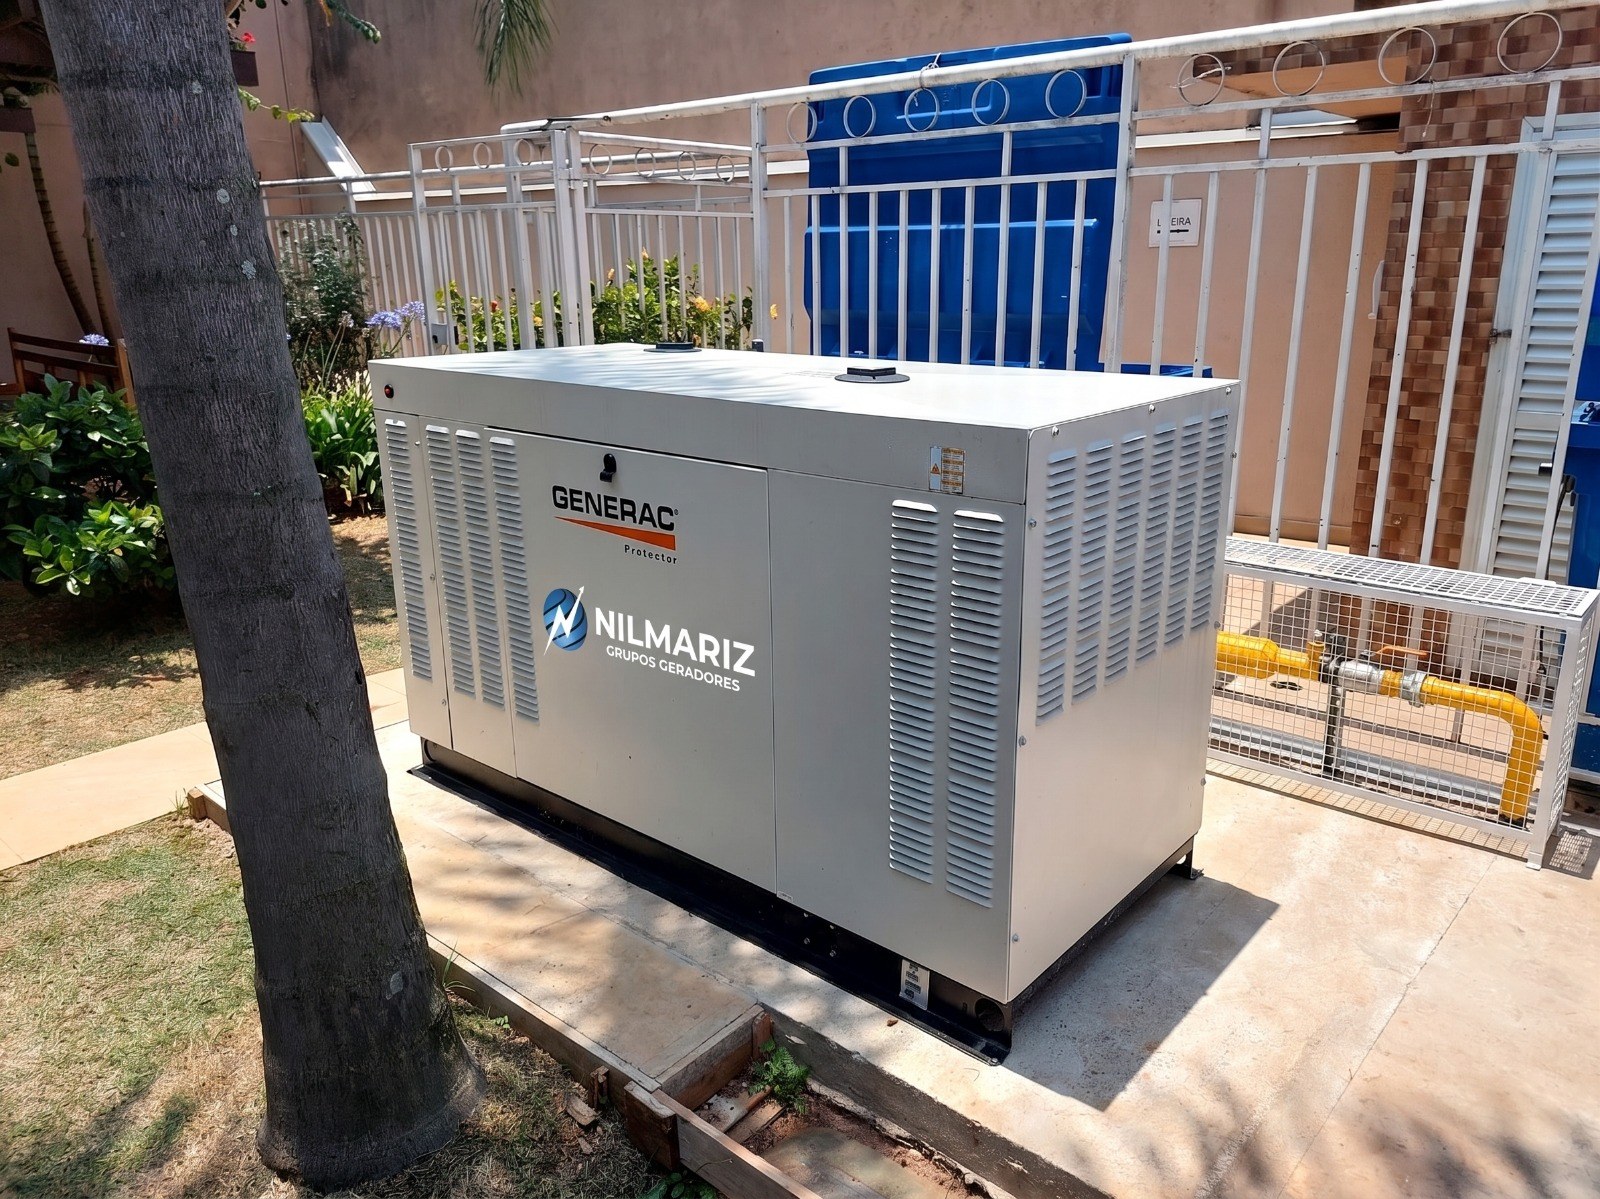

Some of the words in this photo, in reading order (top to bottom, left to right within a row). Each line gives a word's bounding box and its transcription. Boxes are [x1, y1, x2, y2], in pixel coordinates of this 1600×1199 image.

[1157, 217, 1191, 227] LEIRA
[552, 485, 675, 531] GENERAC
[624, 545, 677, 564] Protector
[595, 607, 756, 677] NILMARIZ
[606, 645, 656, 668] GRUPOS
[659, 659, 741, 692] GERADORES
